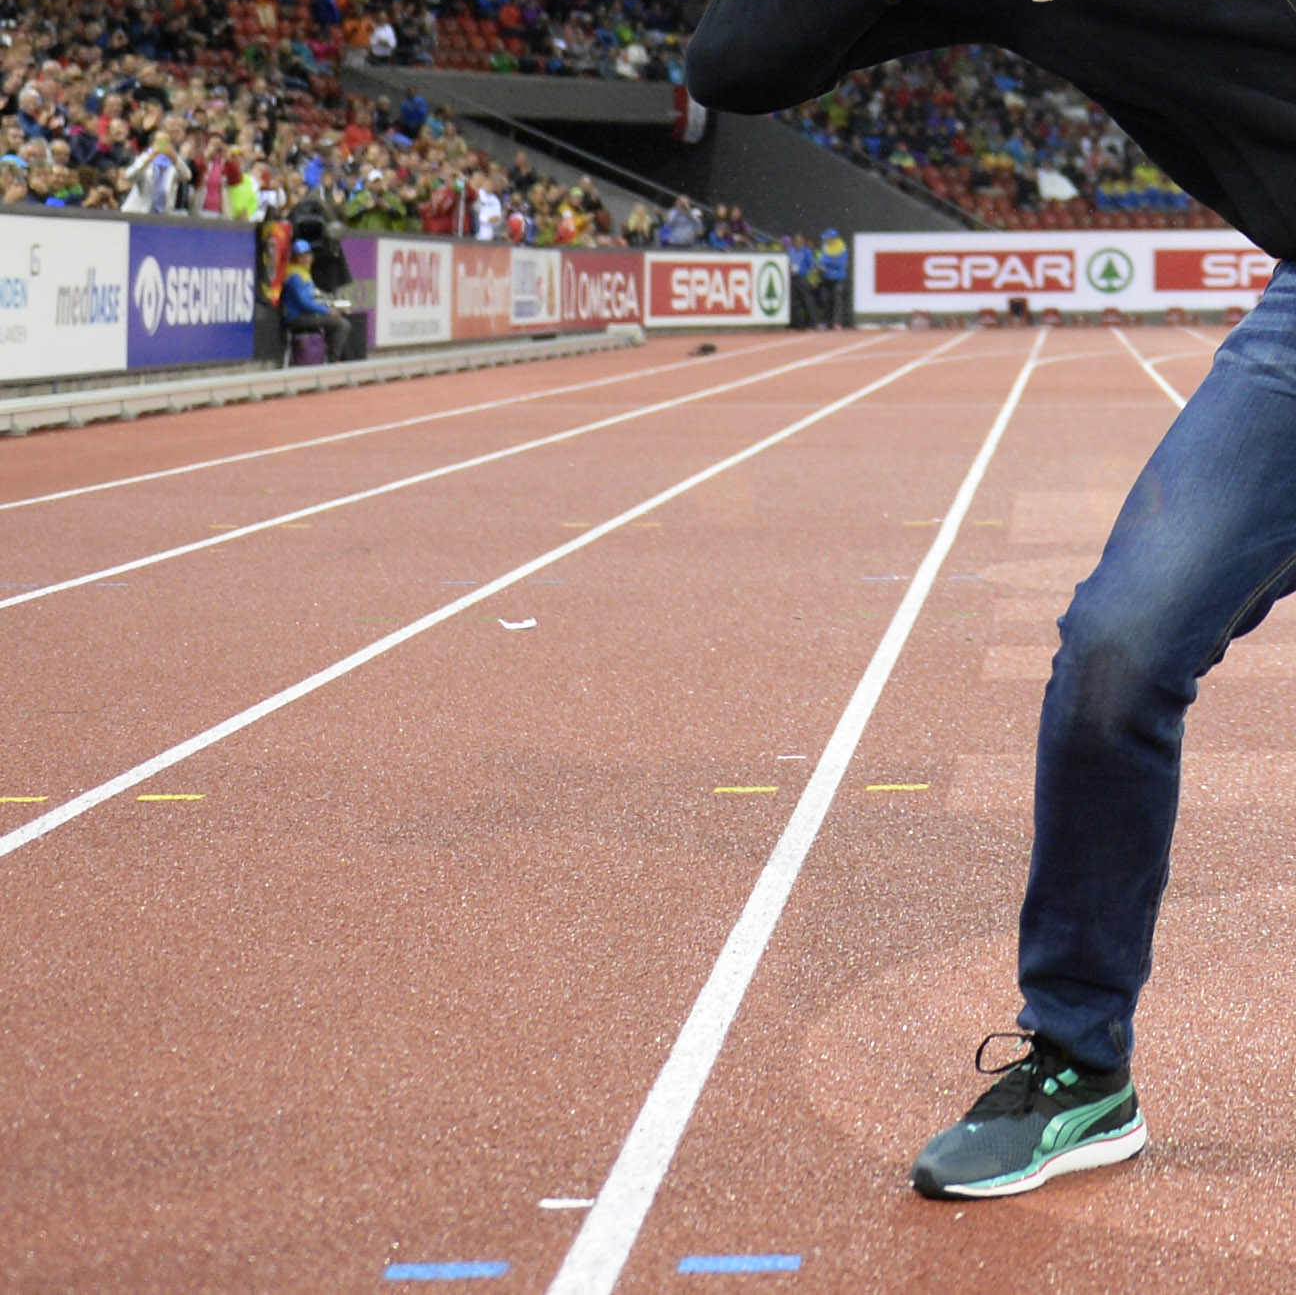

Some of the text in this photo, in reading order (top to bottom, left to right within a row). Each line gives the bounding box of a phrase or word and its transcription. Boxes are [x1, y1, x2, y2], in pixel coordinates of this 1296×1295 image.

[671, 268, 750, 310] SPAR
[923, 254, 1073, 289] SPAR
[1201, 252, 1274, 287] SP
[165, 266, 254, 326] SECURITAS
[578, 271, 640, 318] OMEGA
